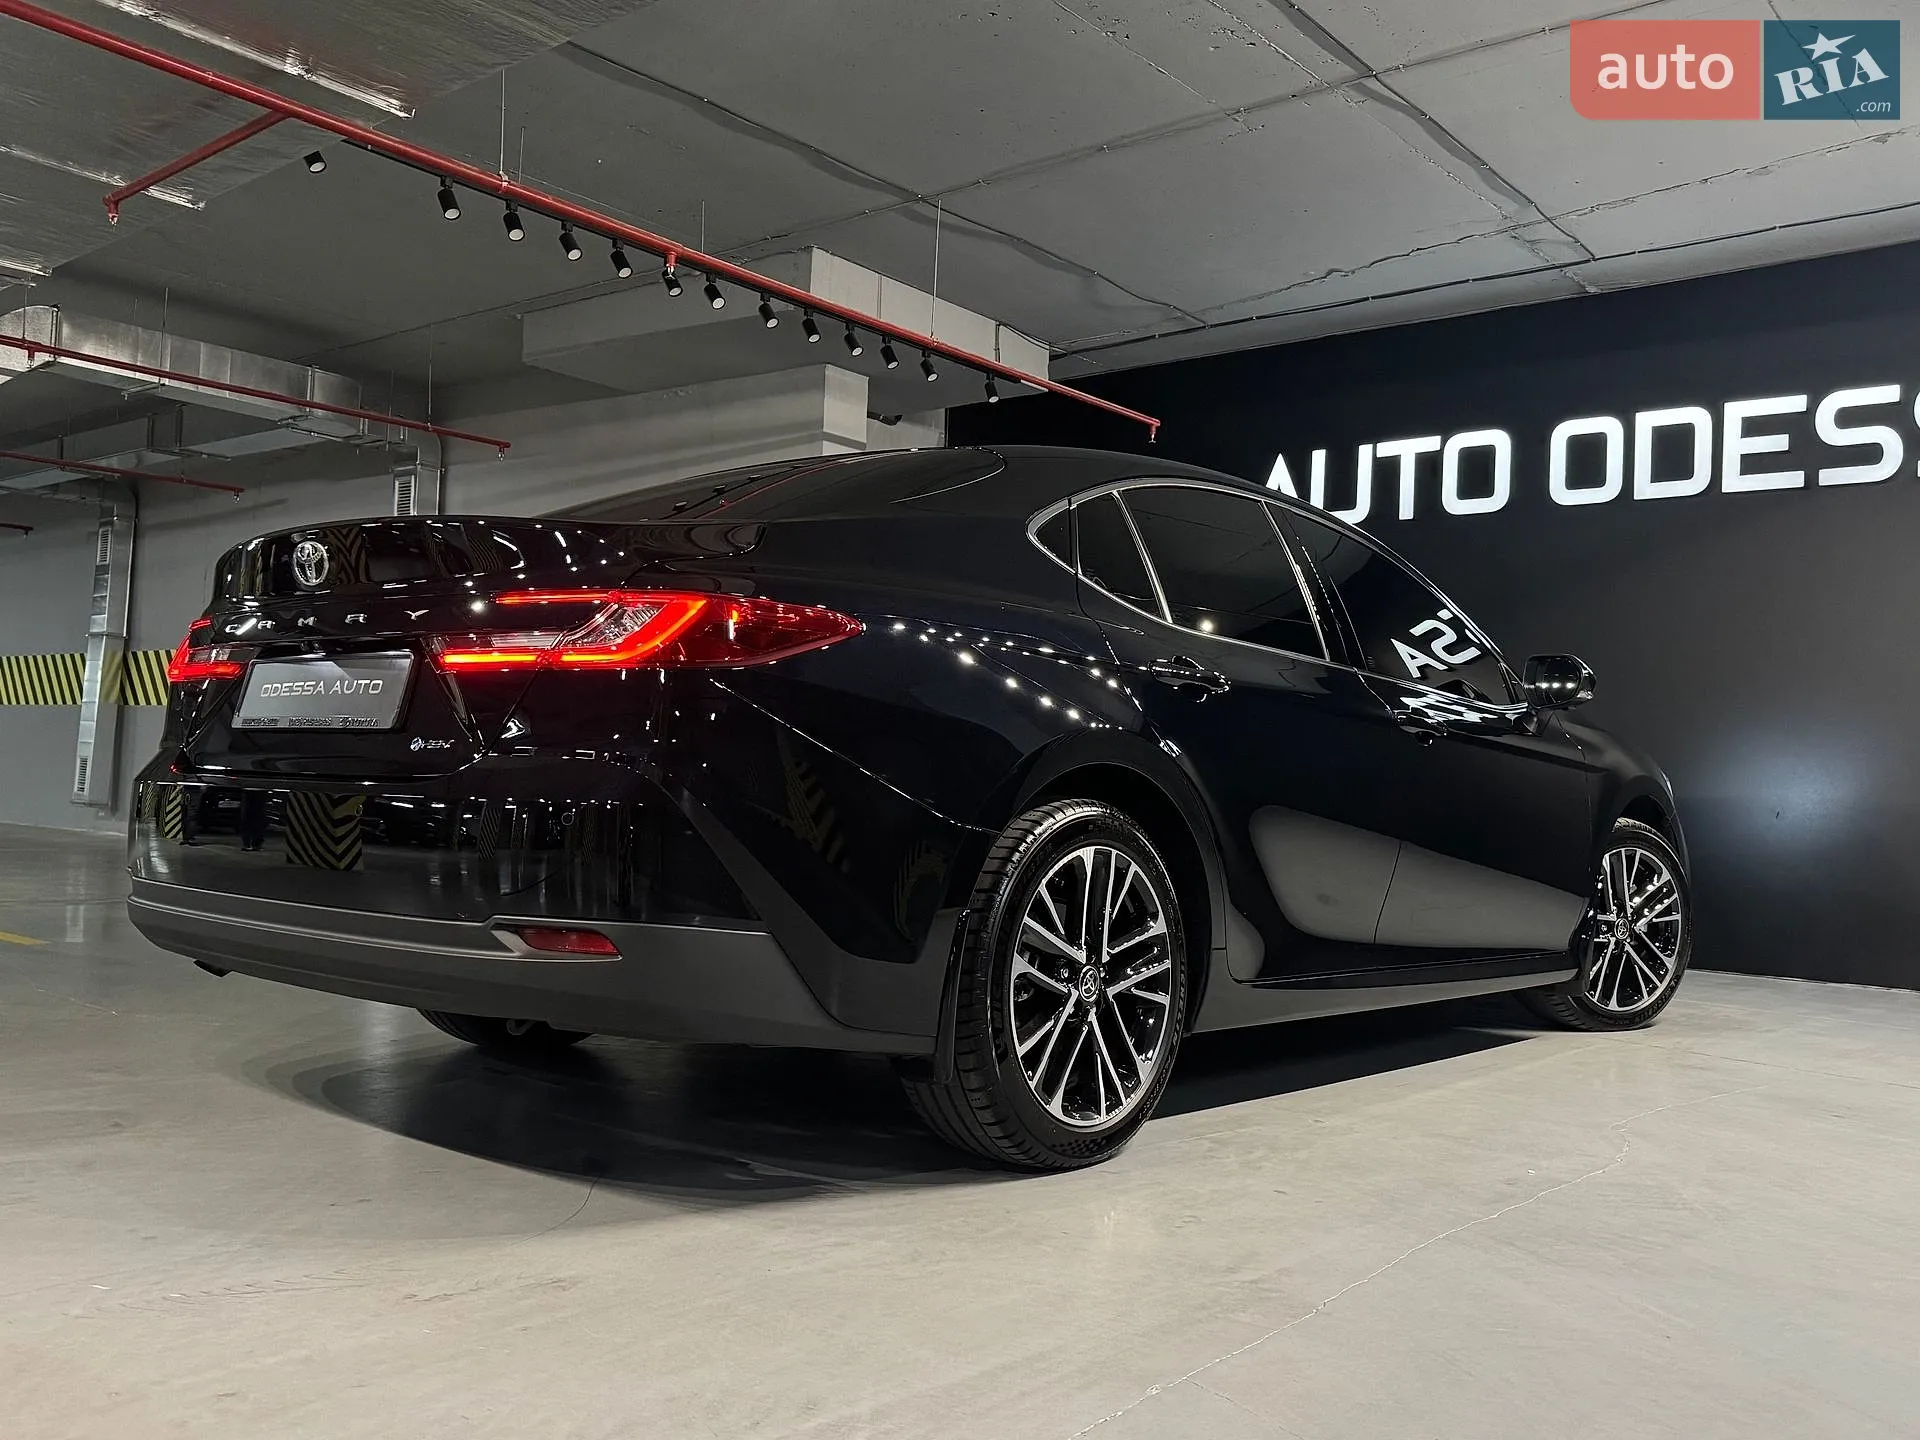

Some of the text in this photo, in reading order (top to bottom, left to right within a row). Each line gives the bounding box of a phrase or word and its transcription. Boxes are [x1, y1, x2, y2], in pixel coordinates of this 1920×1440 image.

[1549, 383, 1920, 506] ODES
[259, 679, 384, 698] ODESSA AUTO
